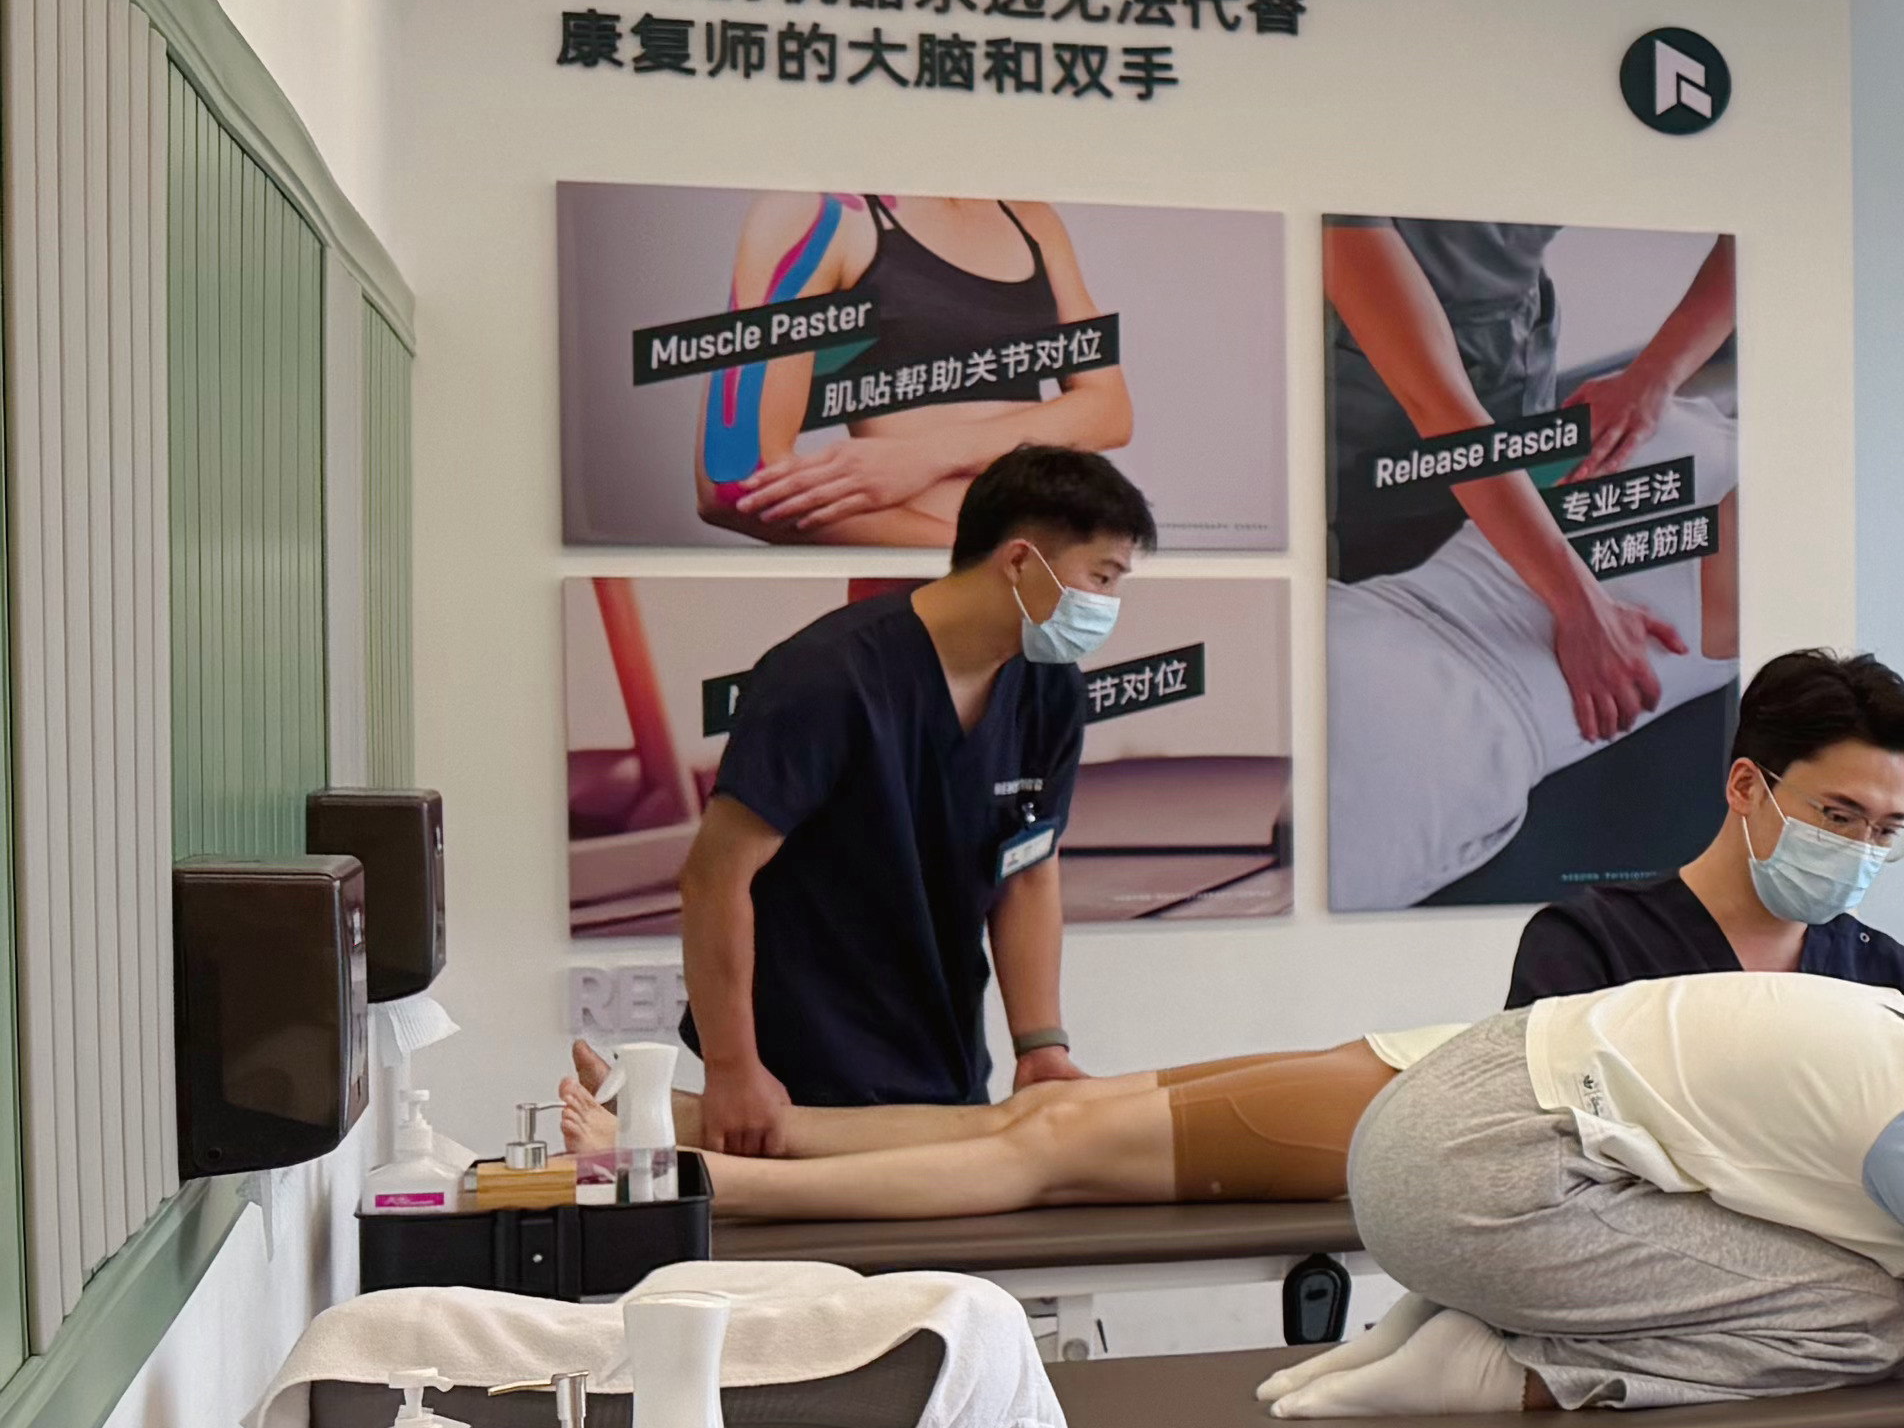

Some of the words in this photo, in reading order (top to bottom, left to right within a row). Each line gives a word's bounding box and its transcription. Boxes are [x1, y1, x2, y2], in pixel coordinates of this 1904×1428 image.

[555, 8, 1180, 101] 康复师的大脑和双手
[651, 322, 760, 370] Muscle
[770, 300, 873, 345] Paster
[822, 328, 1103, 418] 肌贴帮助关节对位
[1376, 442, 1484, 489] Release
[1492, 419, 1579, 463] Fascia
[1562, 470, 1682, 523] 专业手法
[1590, 516, 1710, 573] 松解筋膜
[1088, 659, 1189, 713] 节对位
